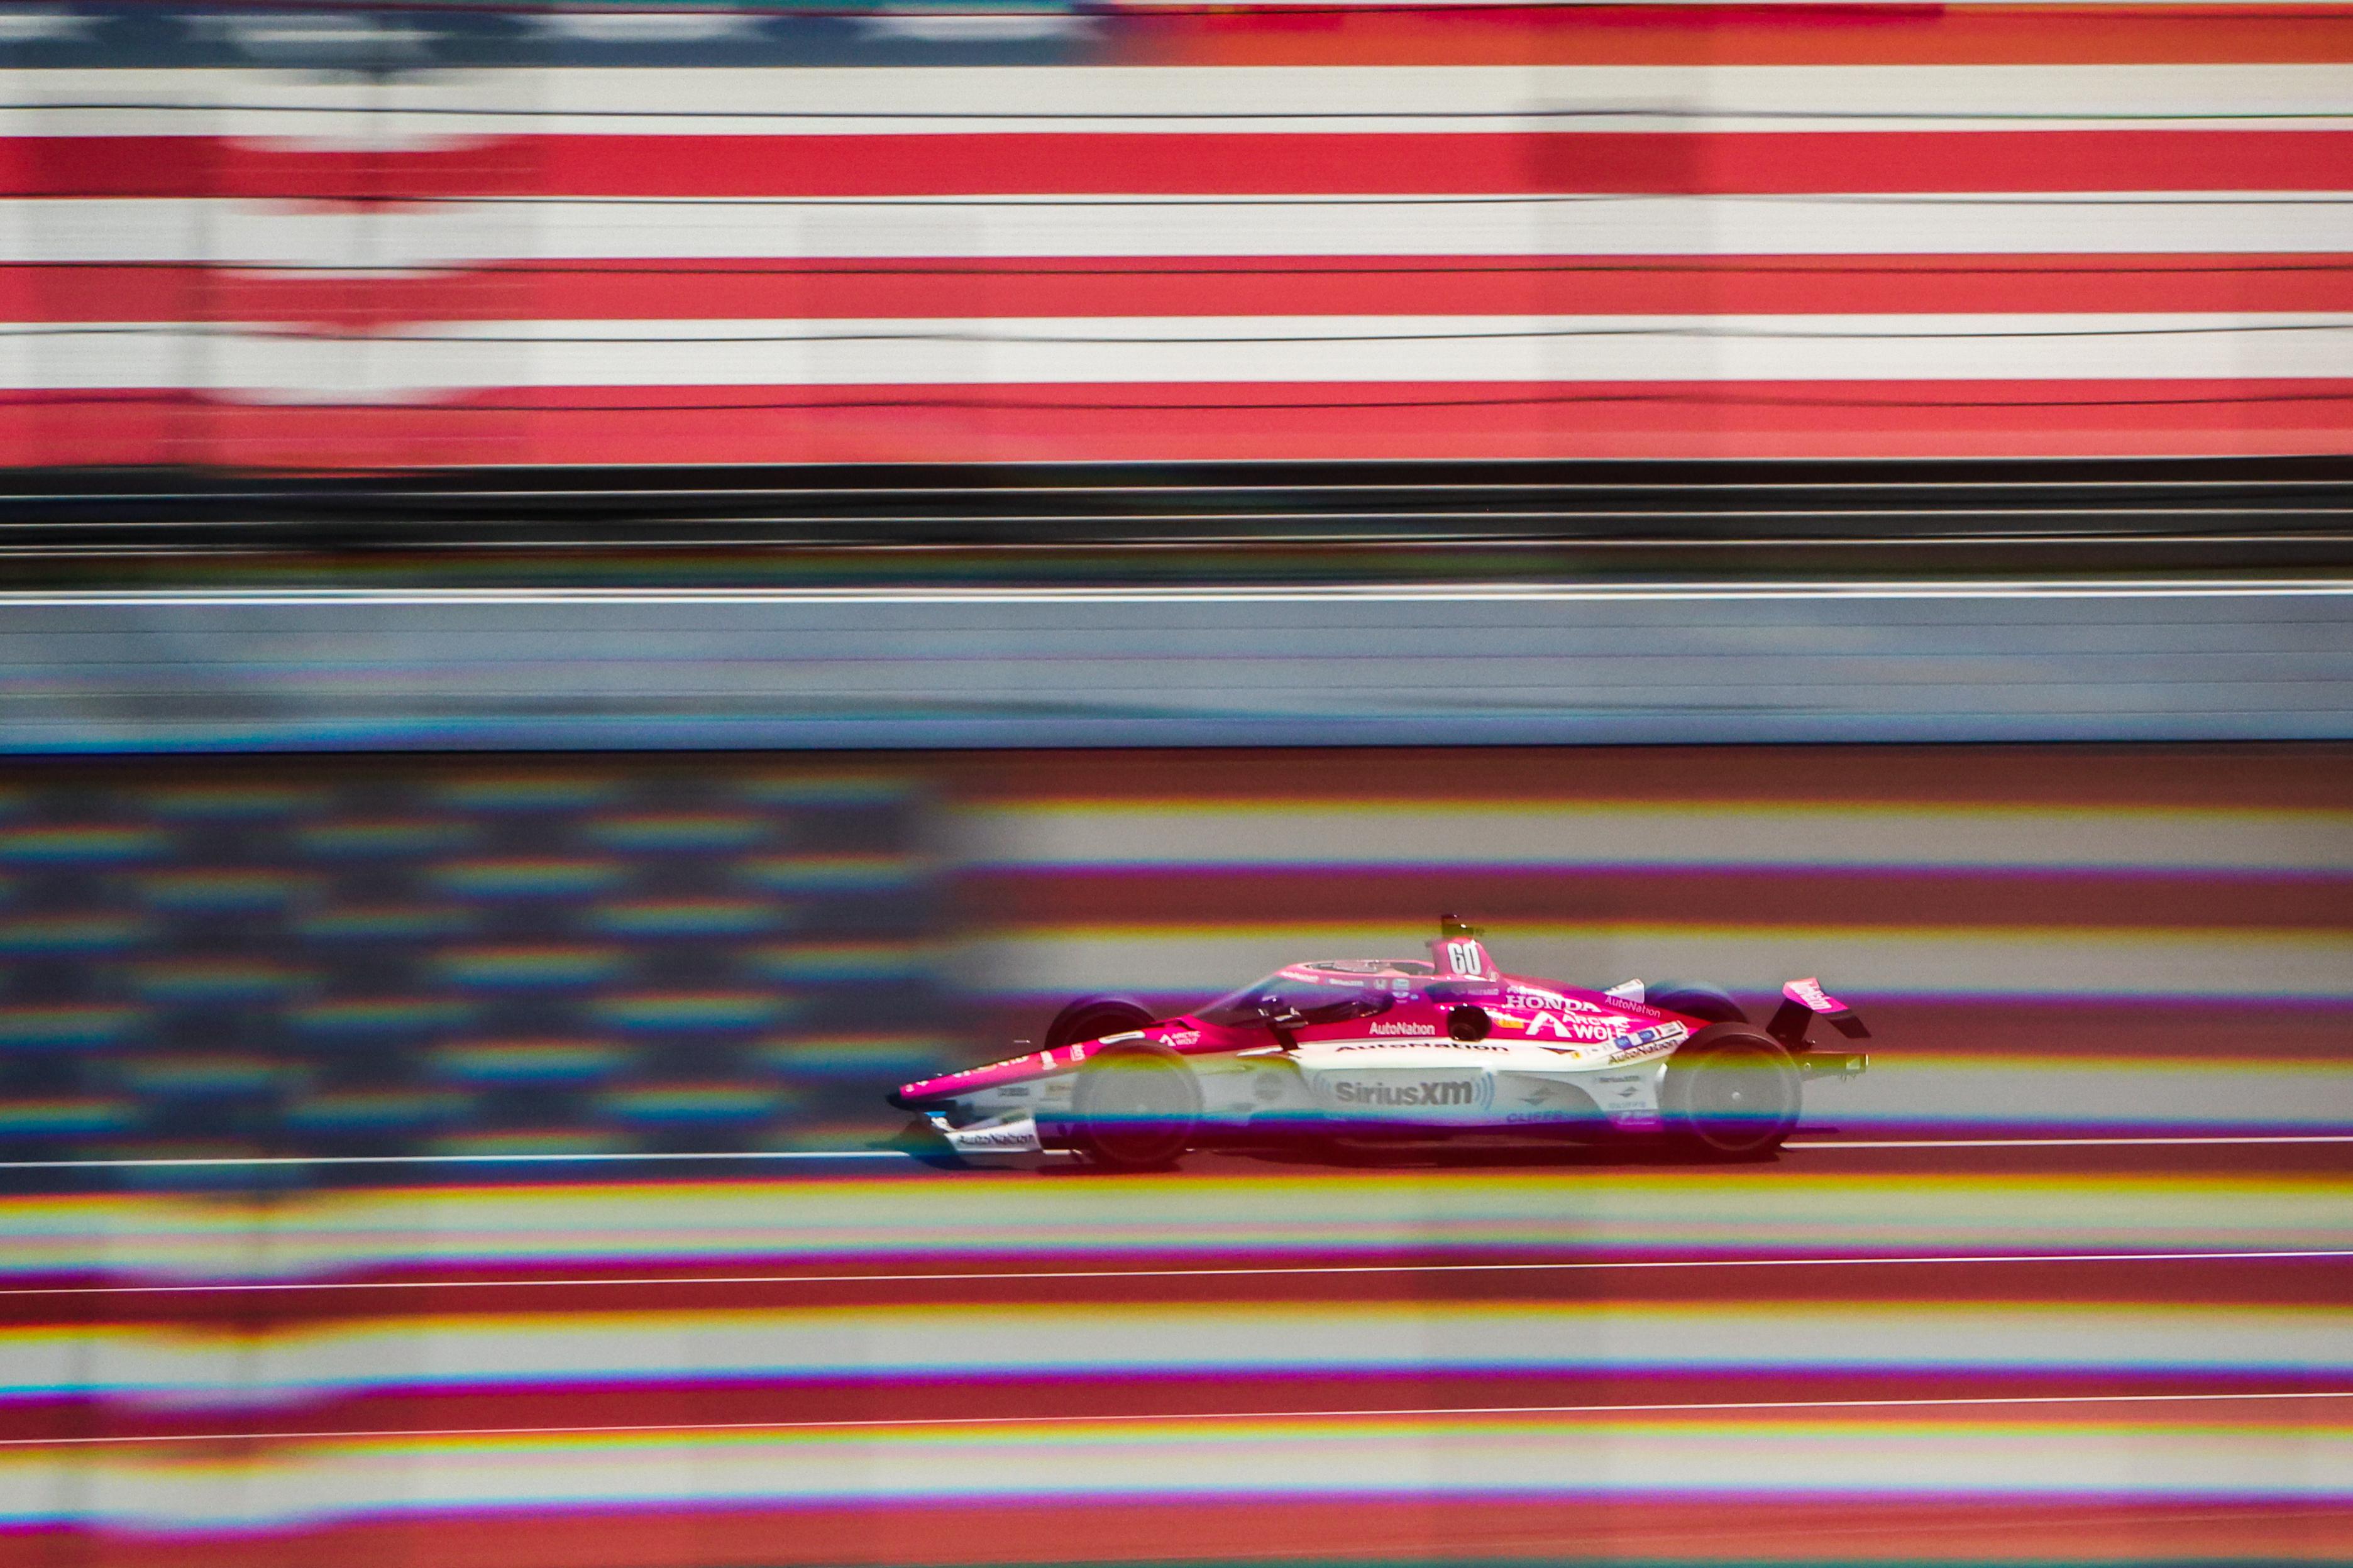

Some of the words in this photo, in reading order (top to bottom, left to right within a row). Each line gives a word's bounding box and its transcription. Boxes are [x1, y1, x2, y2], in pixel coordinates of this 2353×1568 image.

[1447, 943, 1481, 975] 60
[1506, 995, 1602, 1012] HONDA
[1605, 996, 1660, 1017] AutoNation
[1369, 1021, 1435, 1035] AutoNation
[1573, 1024, 1627, 1040] WOLF
[1335, 1043, 1509, 1052] AutoNation
[1608, 1039, 1678, 1065] AutoNation
[1336, 1080, 1473, 1105] SiriusXM
